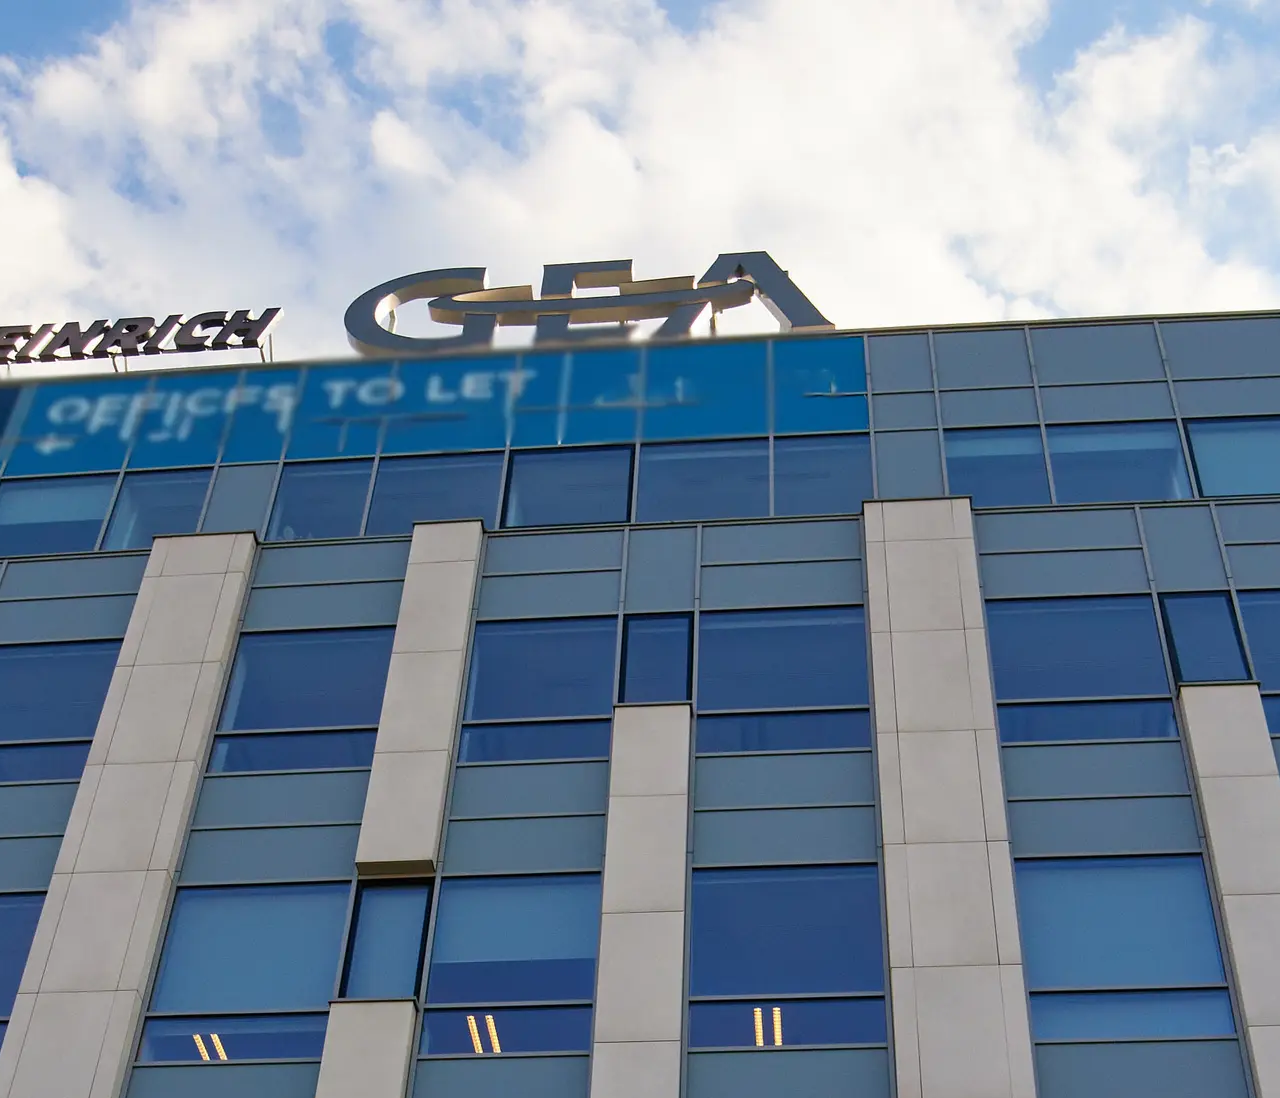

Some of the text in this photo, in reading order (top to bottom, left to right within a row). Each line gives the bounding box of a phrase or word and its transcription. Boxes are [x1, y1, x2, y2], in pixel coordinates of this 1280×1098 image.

[344, 250, 835, 356] GEA
[325, 374, 404, 408] TO
[426, 369, 536, 402] LET
